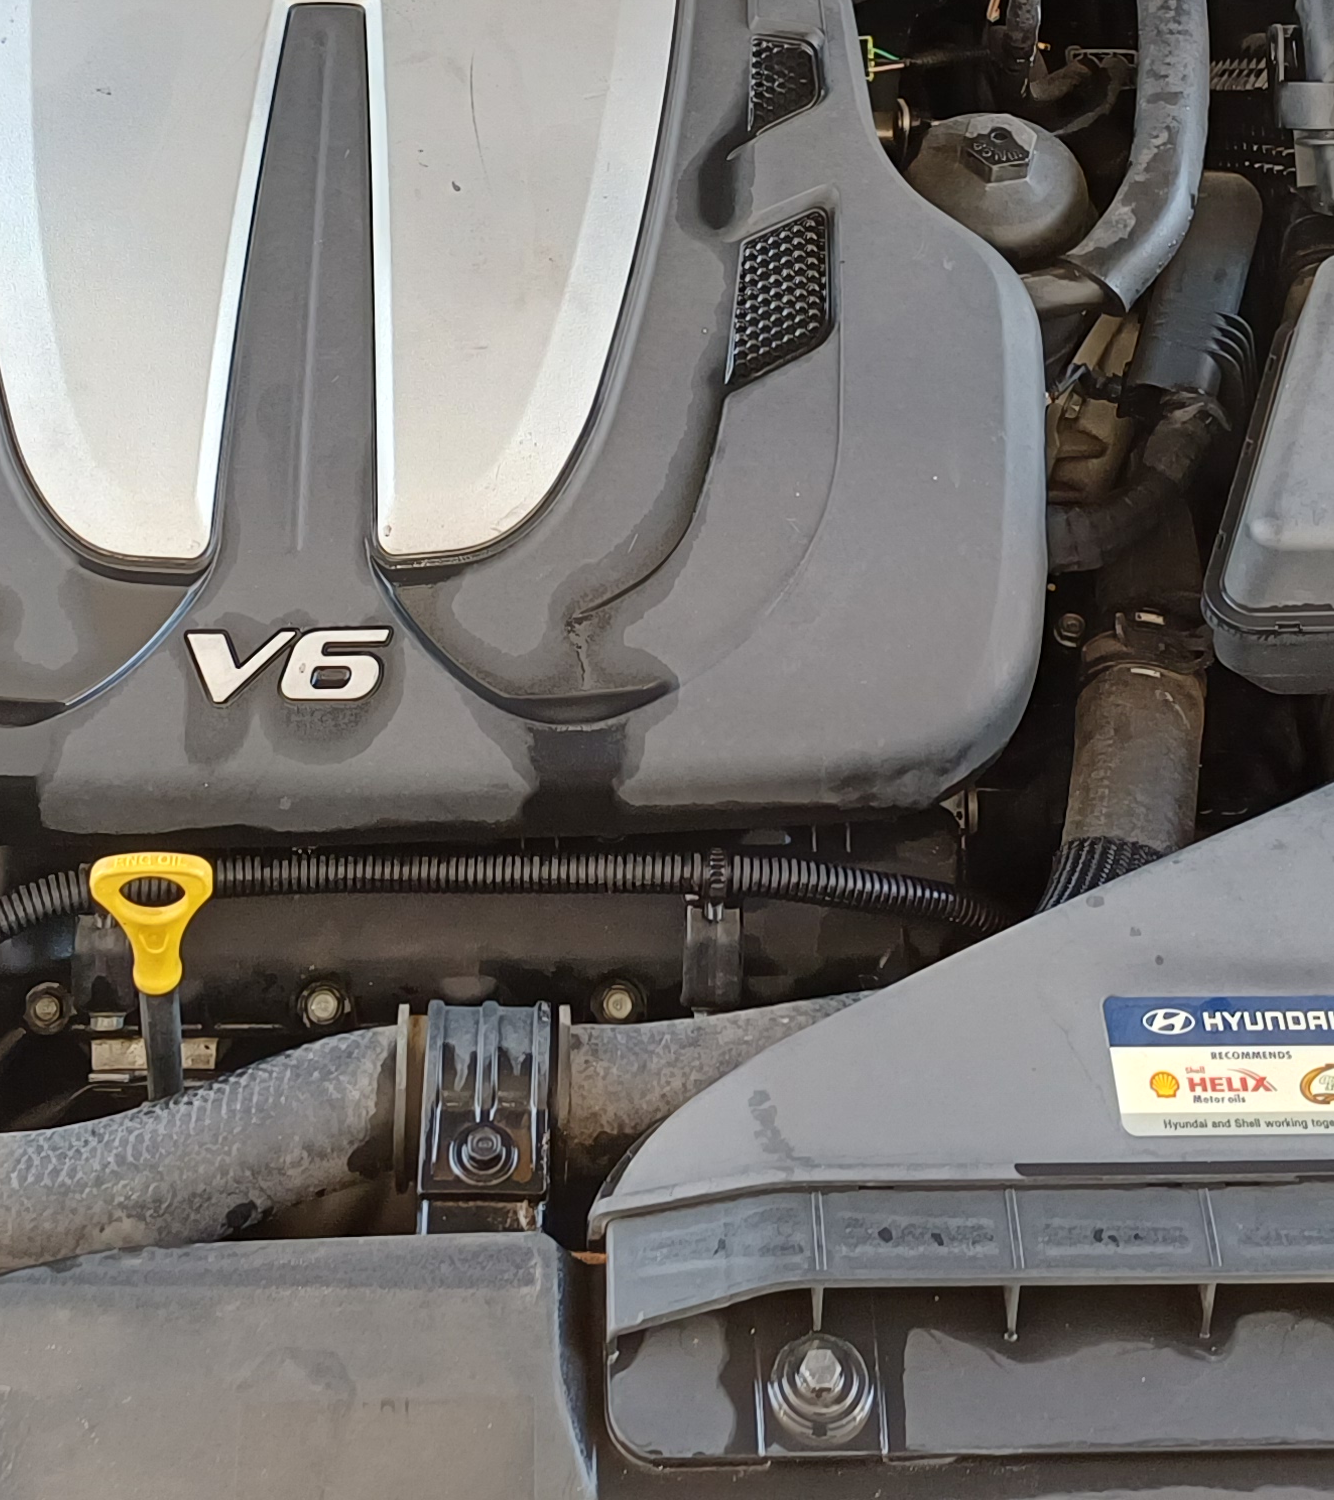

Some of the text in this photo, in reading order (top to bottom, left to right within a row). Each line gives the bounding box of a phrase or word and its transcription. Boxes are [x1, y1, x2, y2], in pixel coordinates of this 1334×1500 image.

[184, 627, 394, 704] V6
[157, 854, 187, 867] OIL
[1210, 1051, 1292, 1060] RECOMMENDS
[1186, 1076, 1274, 1093] HELIX
[1193, 1094, 1246, 1104] Motor oils
[1163, 1119, 1208, 1130] Hyundai
[1212, 1118, 1231, 1128] and
[1234, 1118, 1261, 1128] Shell
[1264, 1117, 1308, 1129] working
